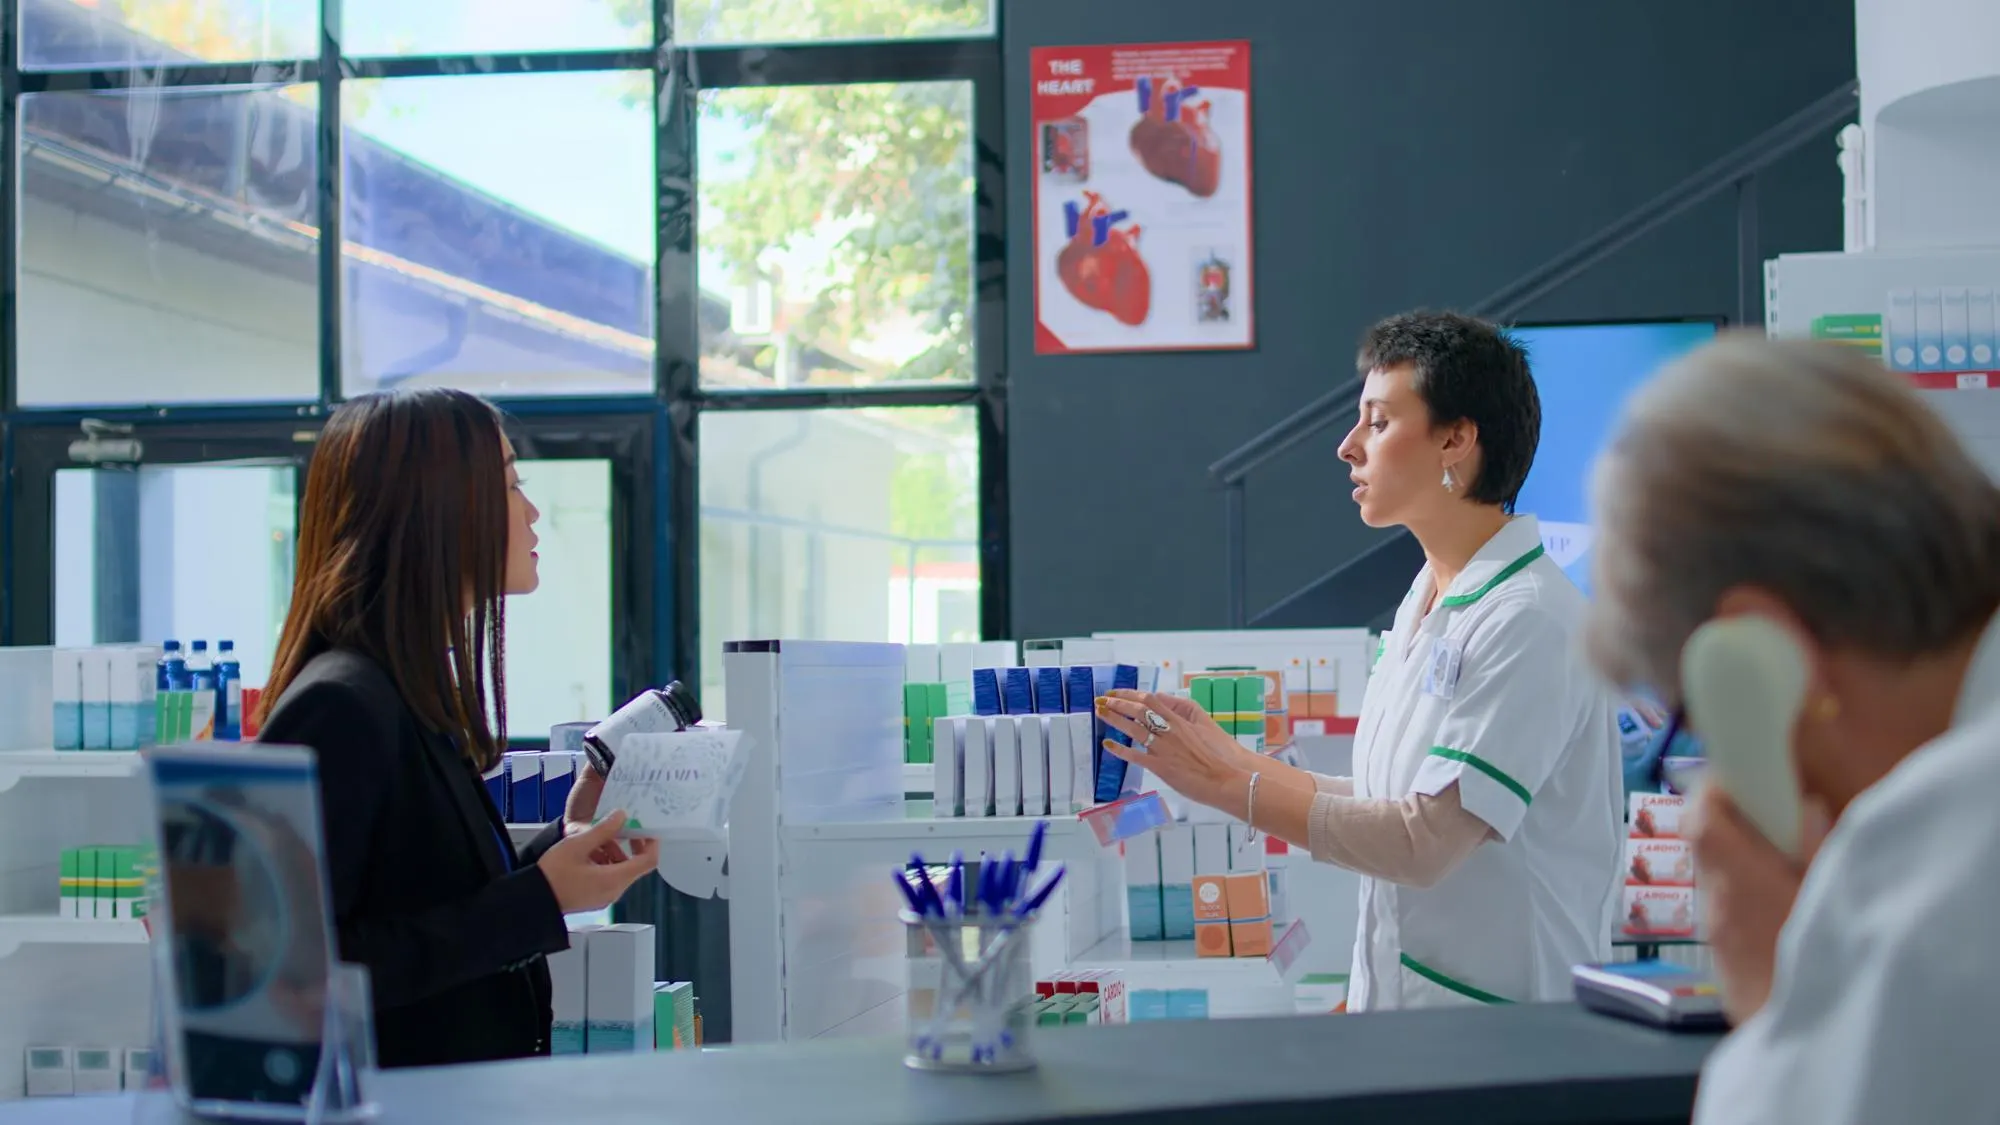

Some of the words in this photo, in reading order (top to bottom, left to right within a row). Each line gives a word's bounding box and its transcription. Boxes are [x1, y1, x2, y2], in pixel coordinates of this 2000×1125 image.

[1047, 59, 1083, 76] THE
[1037, 78, 1095, 95] HEART
[1642, 796, 1684, 807] CARDIO
[1637, 843, 1681, 854] CARDIO
[1635, 890, 1680, 901] CARDIO
[1104, 979, 1121, 1003] CARDIO
